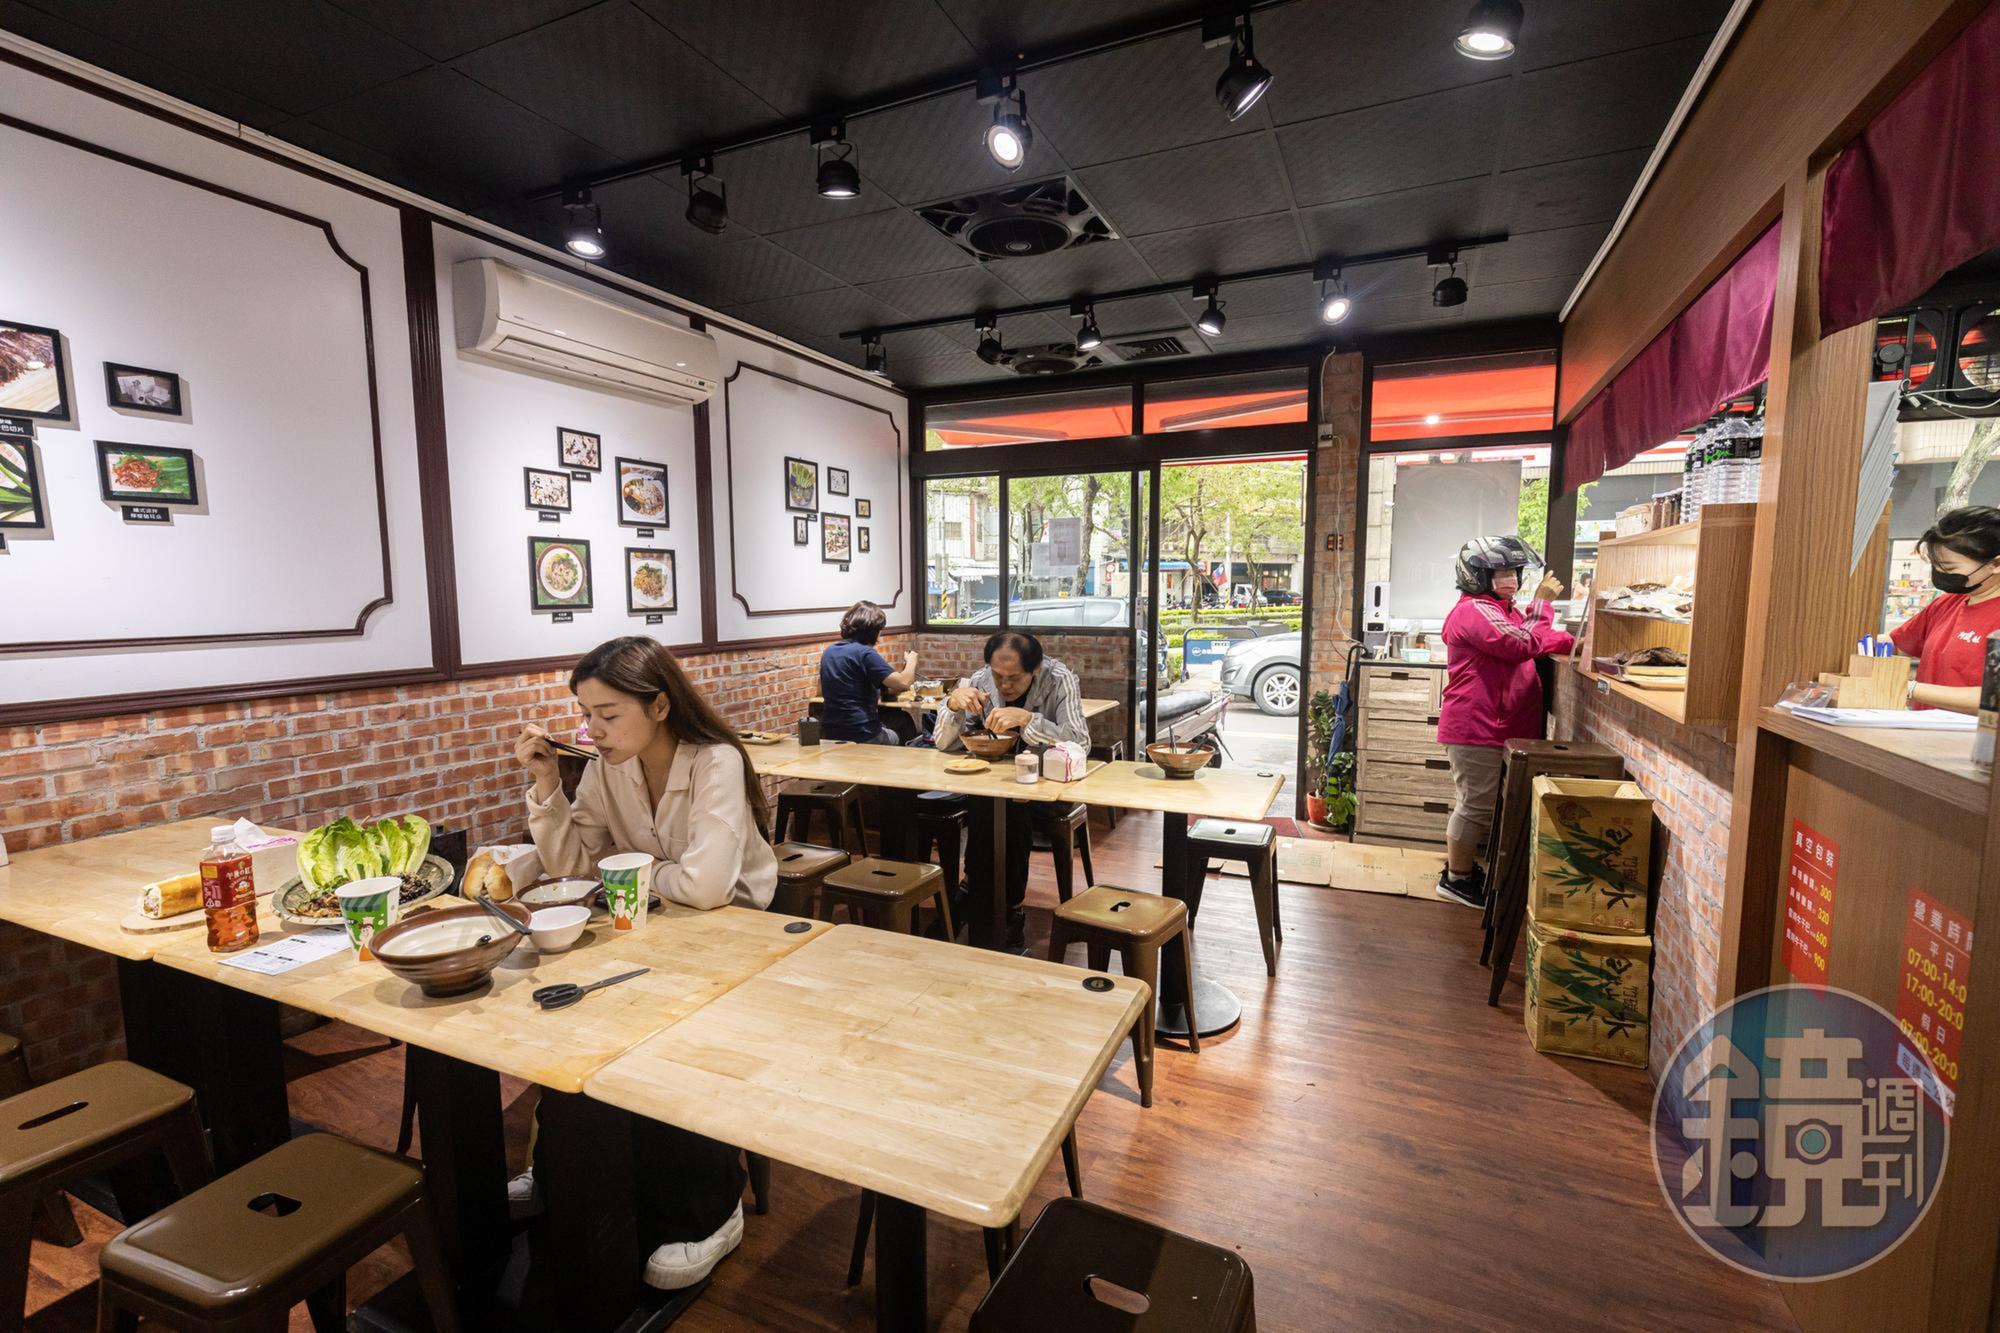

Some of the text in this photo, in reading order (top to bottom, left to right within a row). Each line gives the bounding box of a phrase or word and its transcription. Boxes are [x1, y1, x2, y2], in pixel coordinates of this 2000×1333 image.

[1796, 831, 1834, 868] 真空包裝
[1817, 907, 1830, 925] 320
[1815, 931, 1827, 948] 600
[1813, 952, 1825, 971] 900
[1929, 941, 1955, 970] 平日
